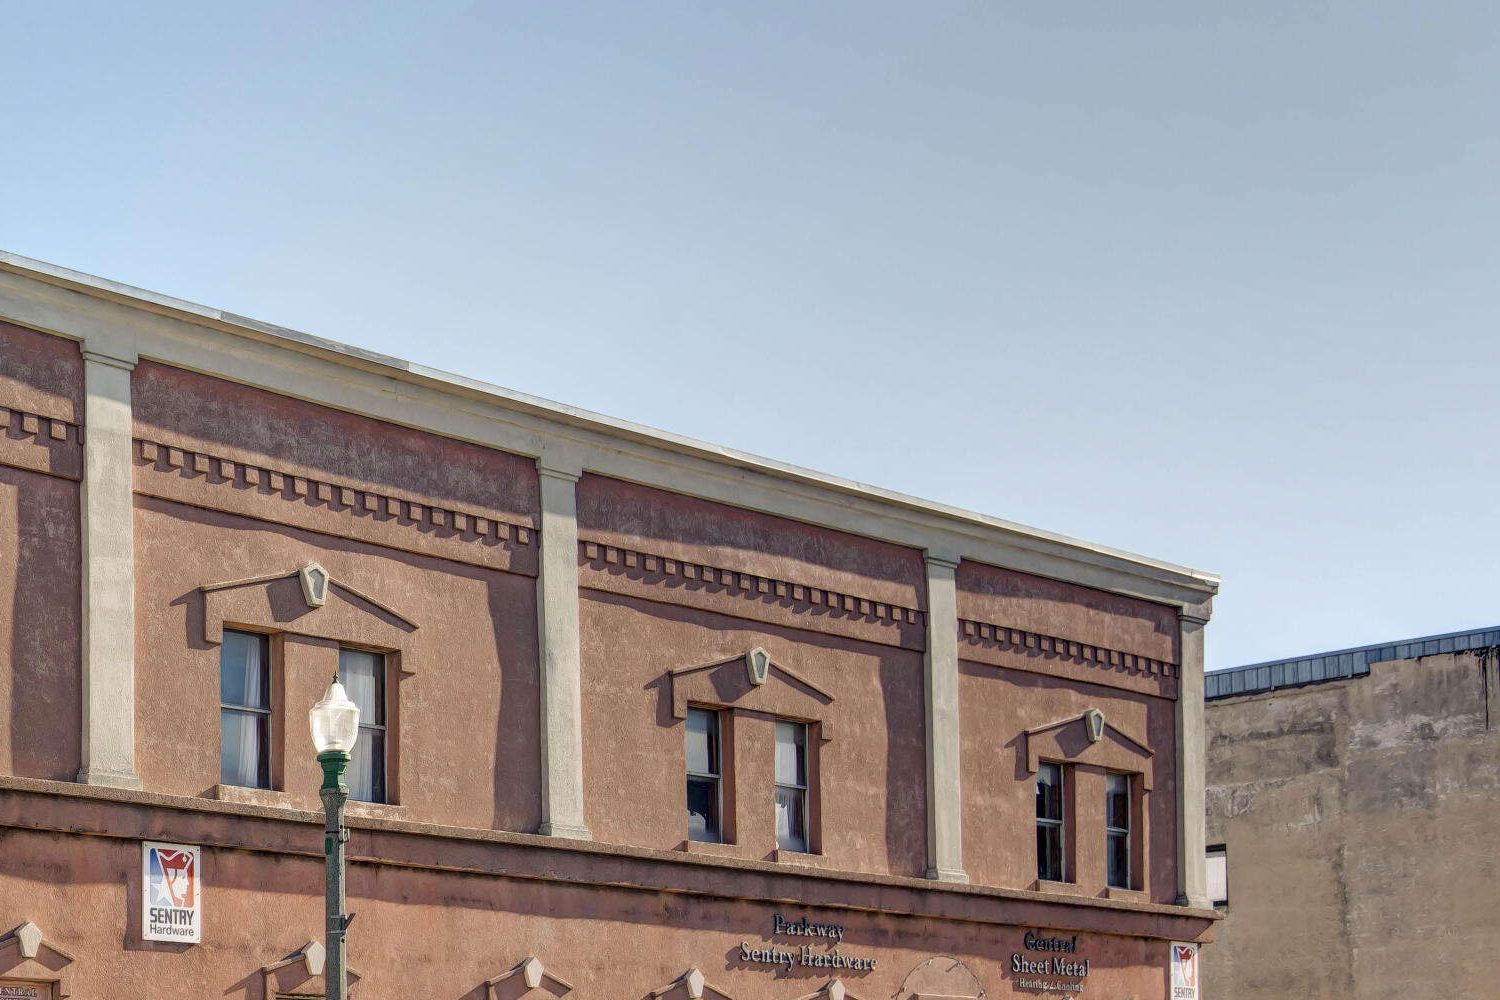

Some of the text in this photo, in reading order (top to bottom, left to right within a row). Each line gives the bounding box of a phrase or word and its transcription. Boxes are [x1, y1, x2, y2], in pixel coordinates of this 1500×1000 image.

[149, 907, 195, 926] SENTRY
[149, 923, 195, 937] Hardware
[773, 913, 844, 945] Parkway
[1023, 930, 1077, 954] Central
[739, 940, 879, 972] Sentry Hardware
[1011, 952, 1091, 977] Sheet Metal
[1019, 977, 1048, 991] Heating
[1056, 980, 1084, 993] Cooling
[1174, 986, 1195, 998] SENTRY
